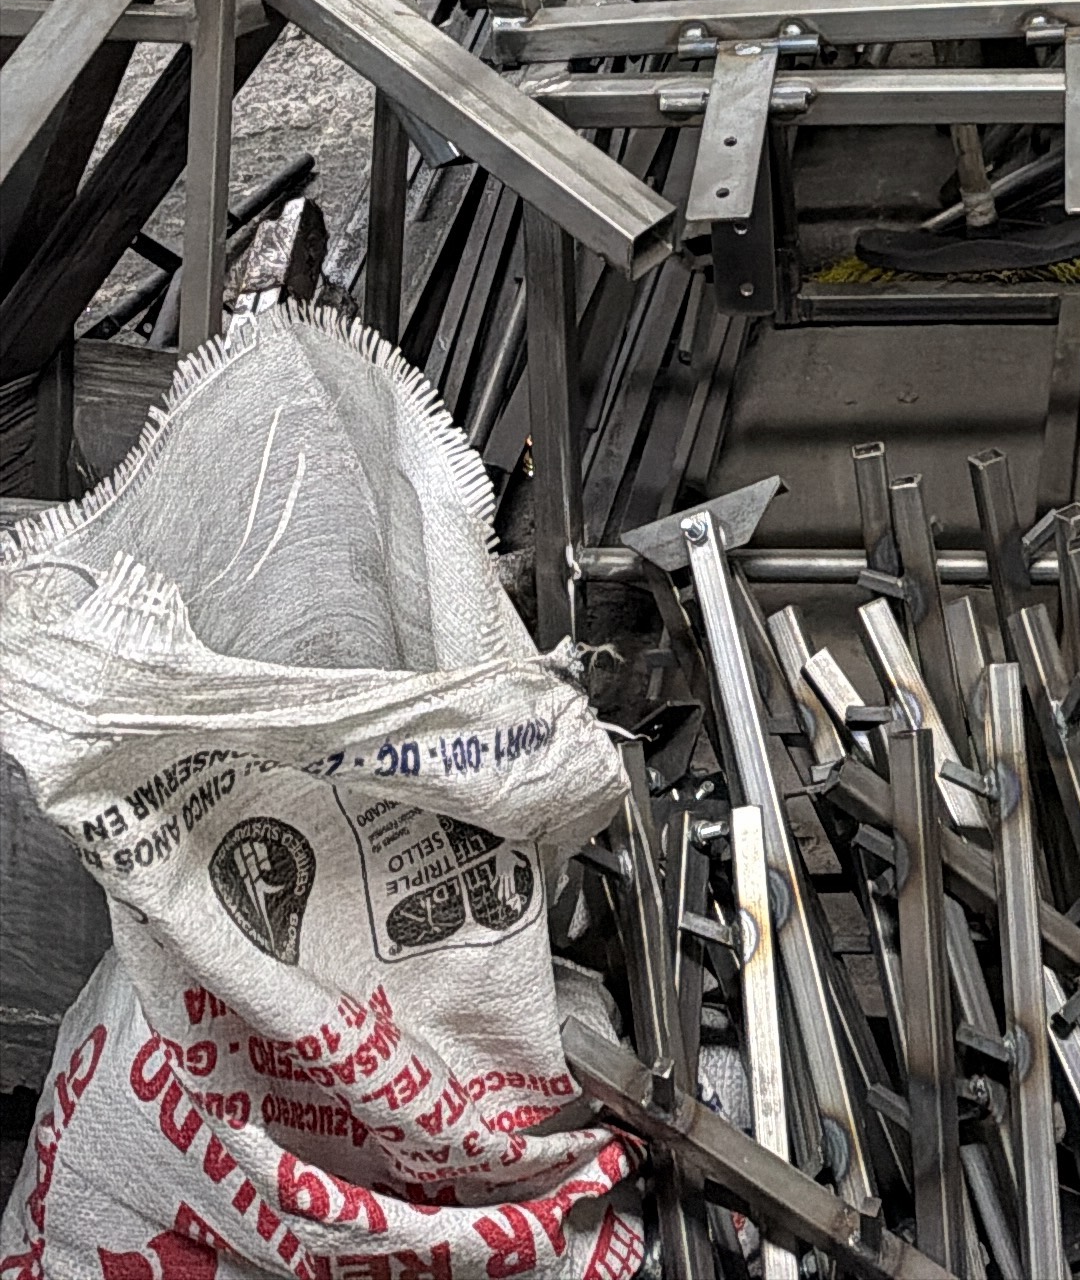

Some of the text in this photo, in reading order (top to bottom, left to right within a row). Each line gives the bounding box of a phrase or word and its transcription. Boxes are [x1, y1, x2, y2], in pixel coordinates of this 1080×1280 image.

[182, 768, 236, 834] CINCO
[81, 805, 129, 843] EN
[388, 830, 445, 873] SELLO
[385, 854, 456, 896] TRIPLE
